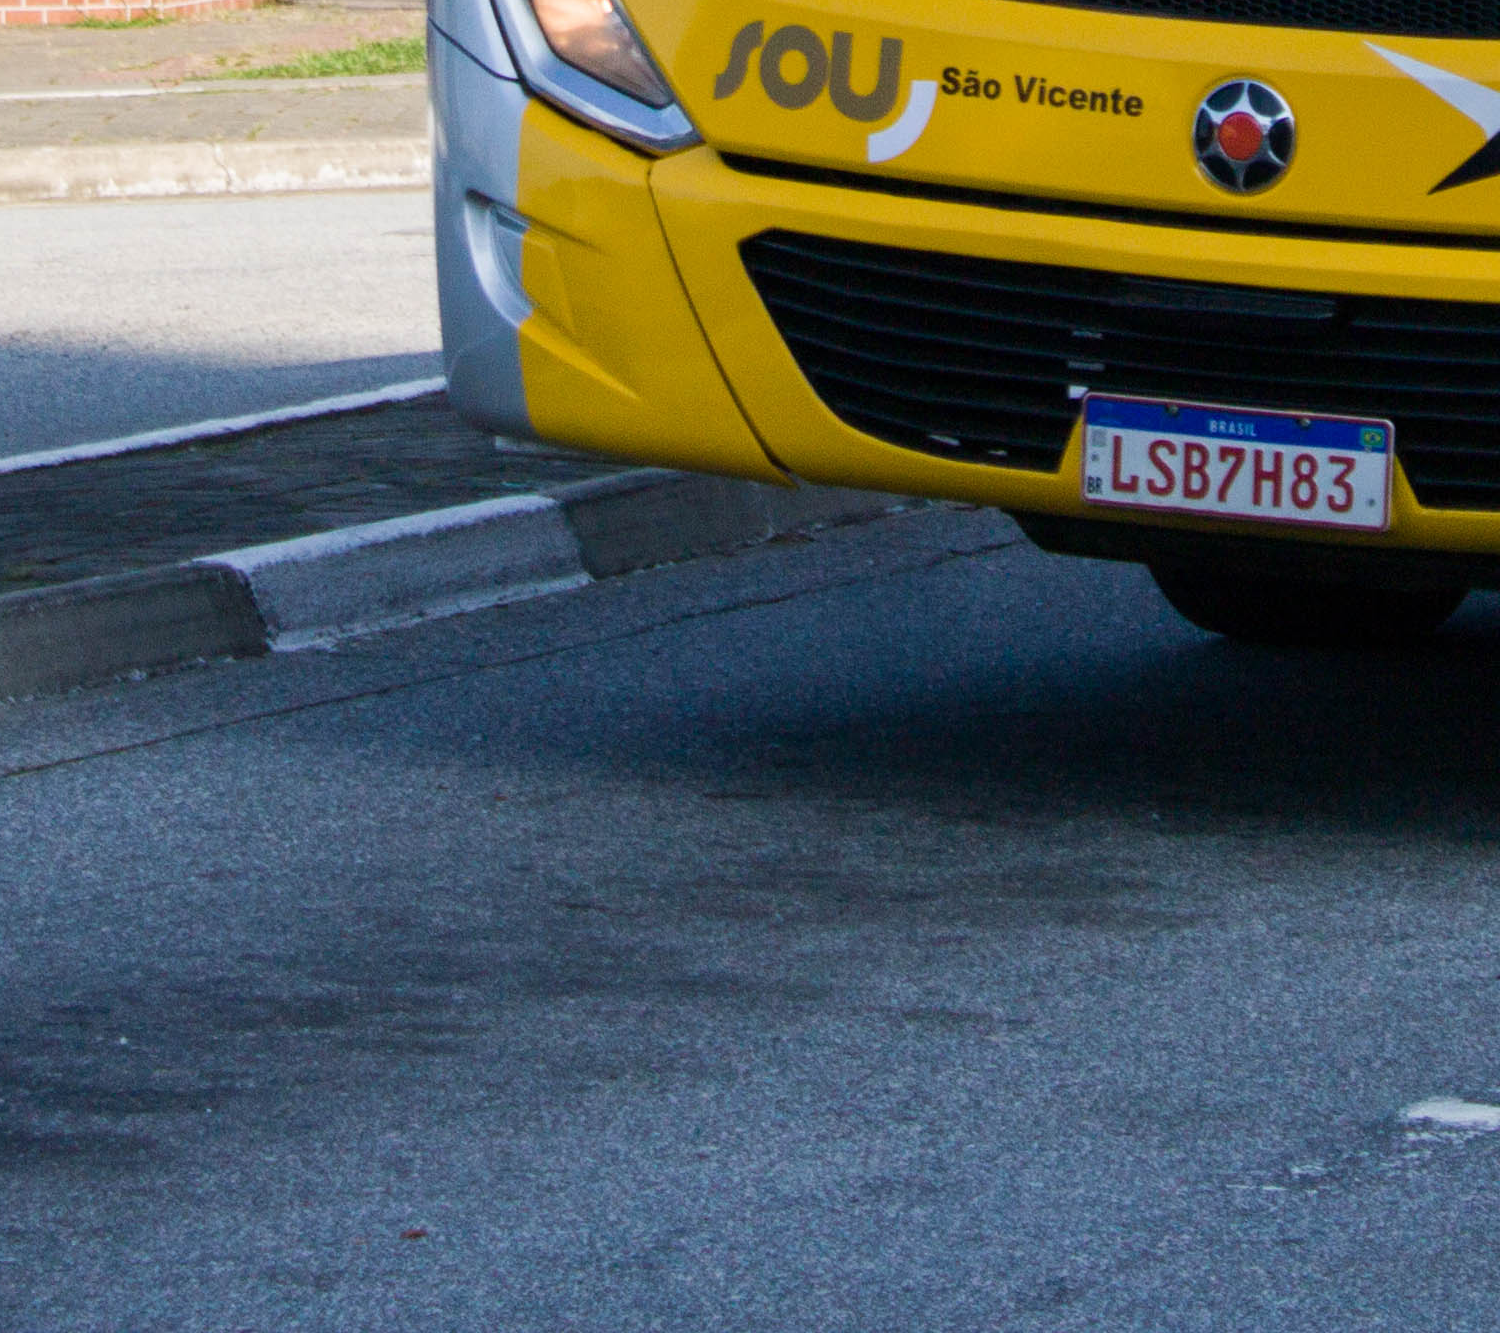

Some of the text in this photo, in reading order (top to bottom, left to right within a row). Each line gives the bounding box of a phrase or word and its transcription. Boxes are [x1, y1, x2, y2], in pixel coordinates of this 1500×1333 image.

[941, 67, 1001, 101] São
[1014, 75, 1144, 117] Vicente
[1208, 419, 1257, 438] BRASIL
[1087, 476, 1103, 495] BR
[1111, 435, 1356, 514] LSB7H83
